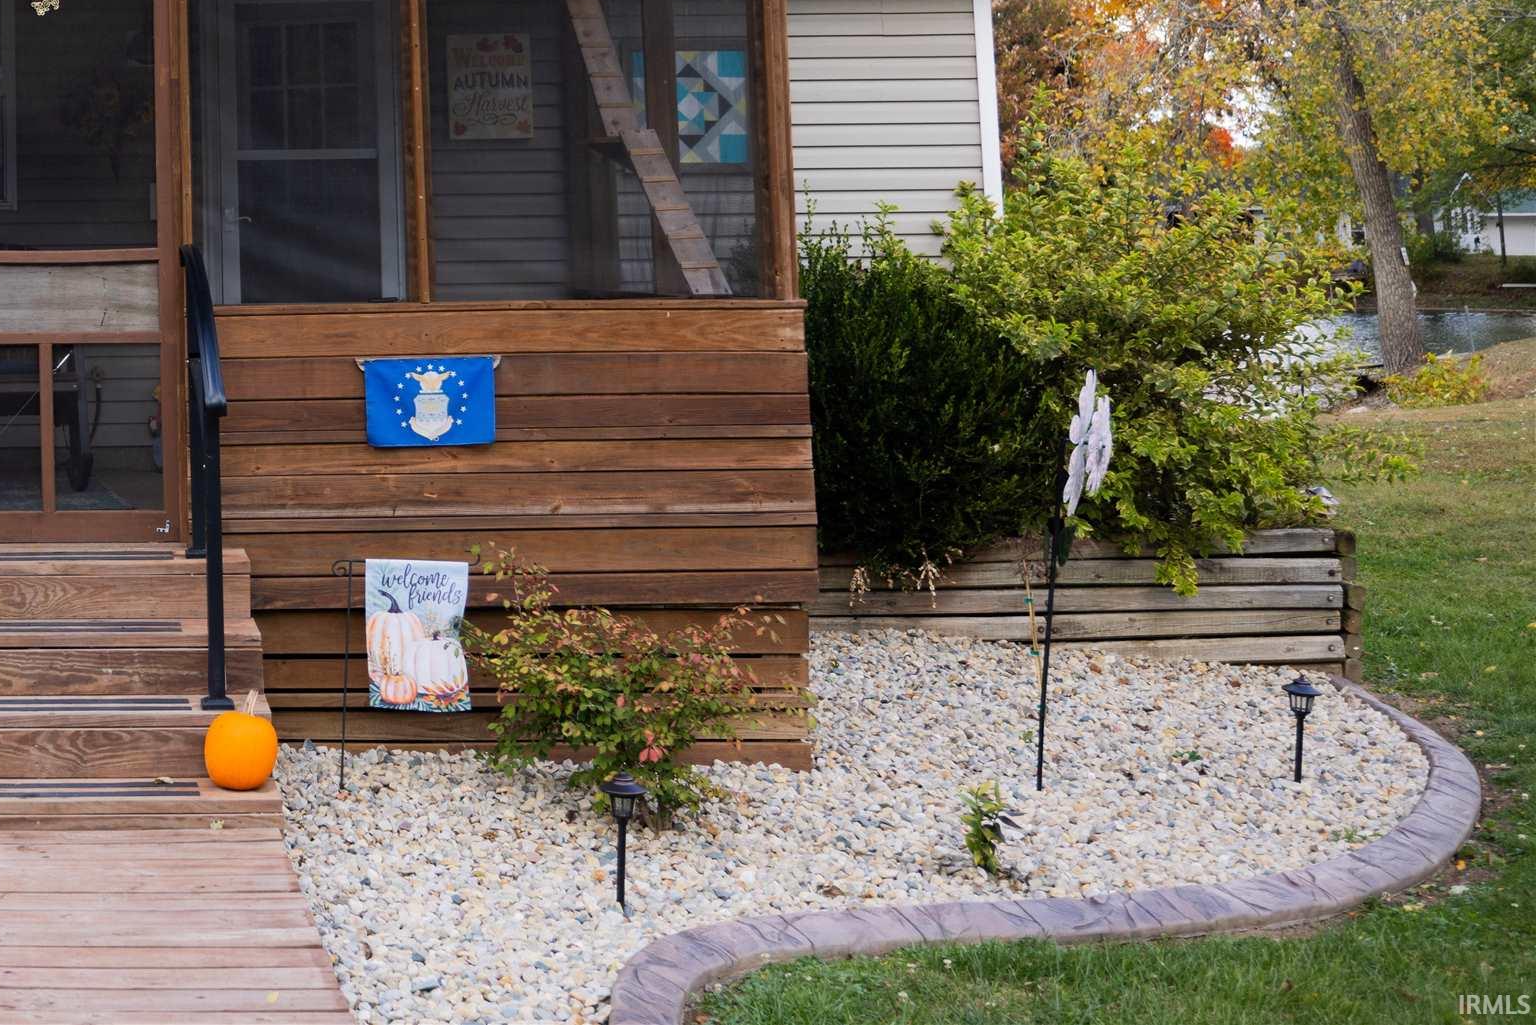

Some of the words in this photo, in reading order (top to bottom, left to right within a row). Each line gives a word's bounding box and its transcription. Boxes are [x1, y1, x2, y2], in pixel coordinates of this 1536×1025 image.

[453, 71, 529, 90] AUTUMN
[381, 563, 449, 589] welcome
[408, 583, 463, 610] friends
